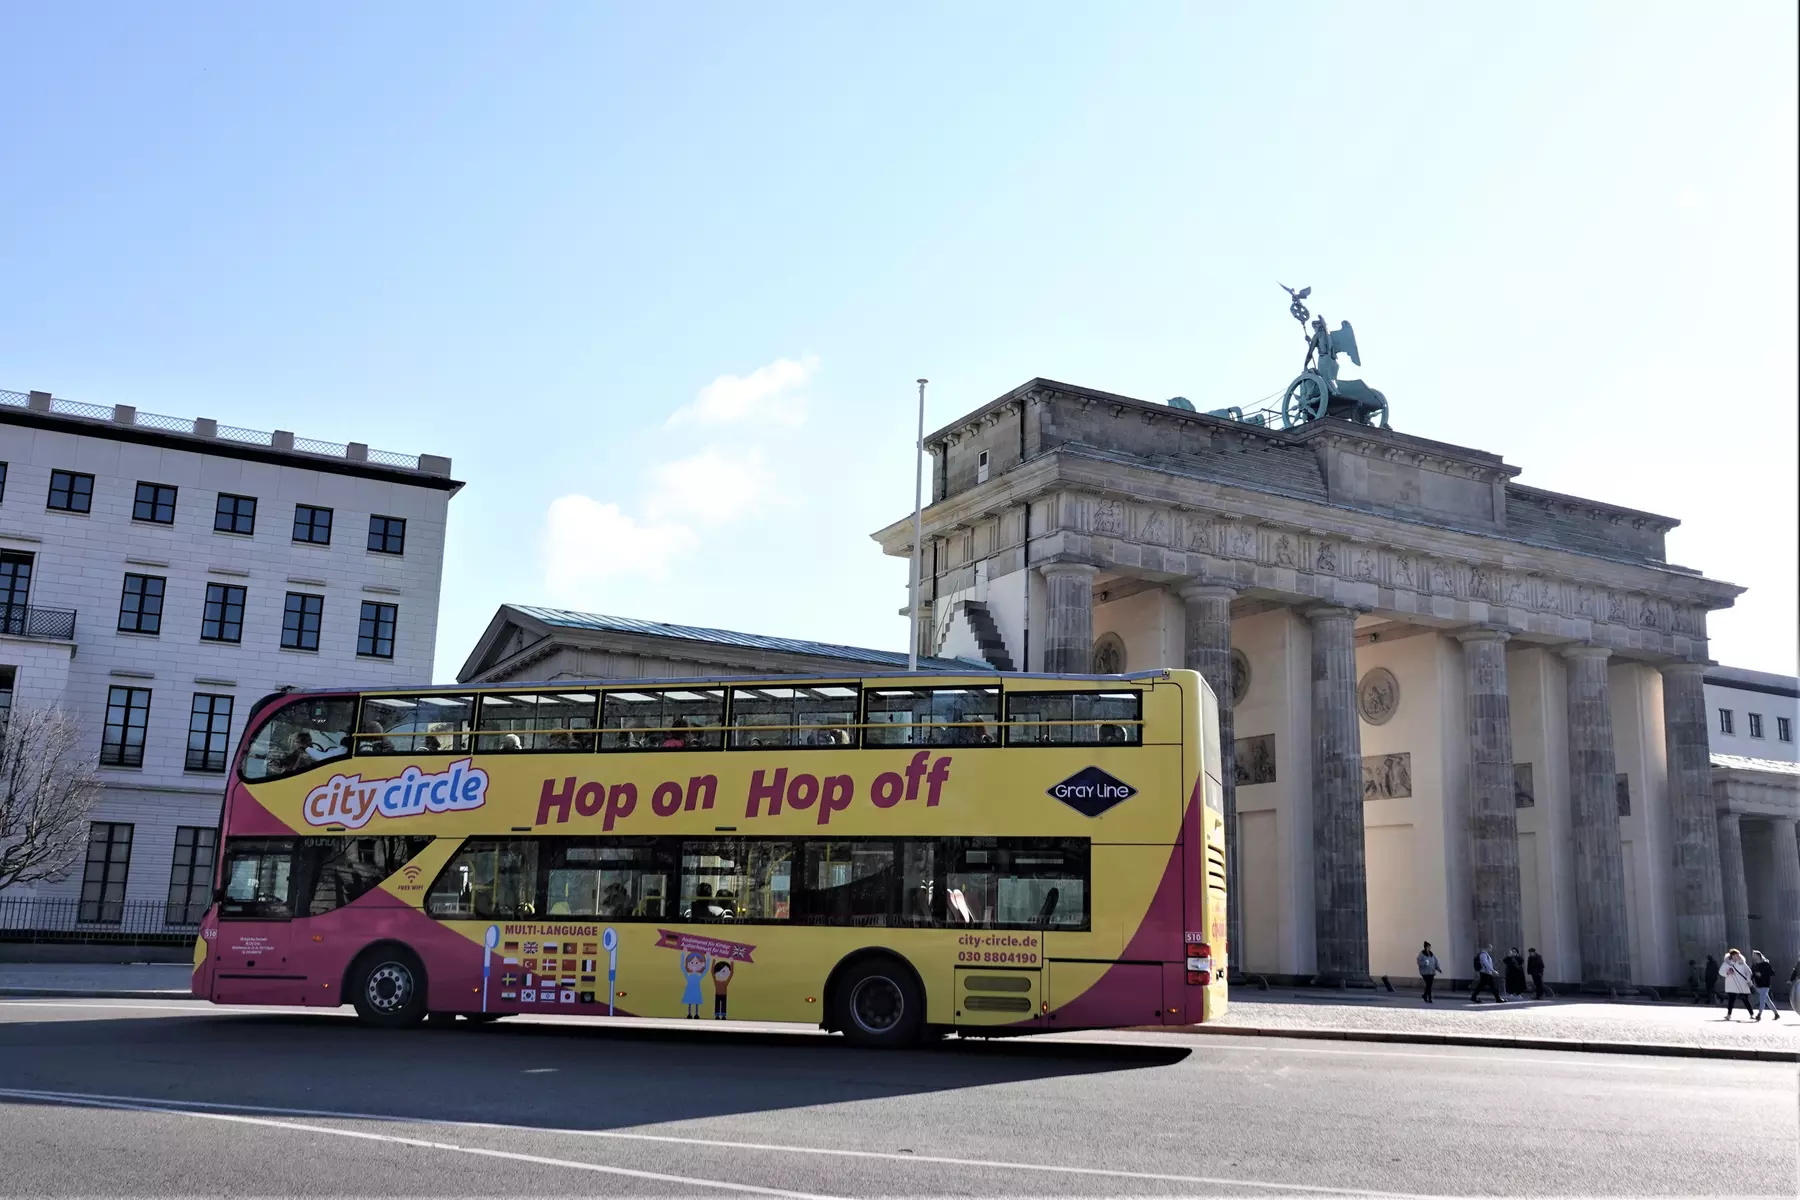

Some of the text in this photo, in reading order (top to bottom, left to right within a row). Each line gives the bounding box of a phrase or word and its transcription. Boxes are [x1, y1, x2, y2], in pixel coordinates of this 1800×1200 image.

[535, 750, 952, 832] Hop on Hop off
[1055, 784, 1129, 798] Gray Line
[505, 925, 598, 937] MULTI-LANGUAGE
[1186, 933, 1201, 941] 510
[958, 933, 1038, 948] city-circle.de
[958, 951, 1037, 964] 030 8804190
